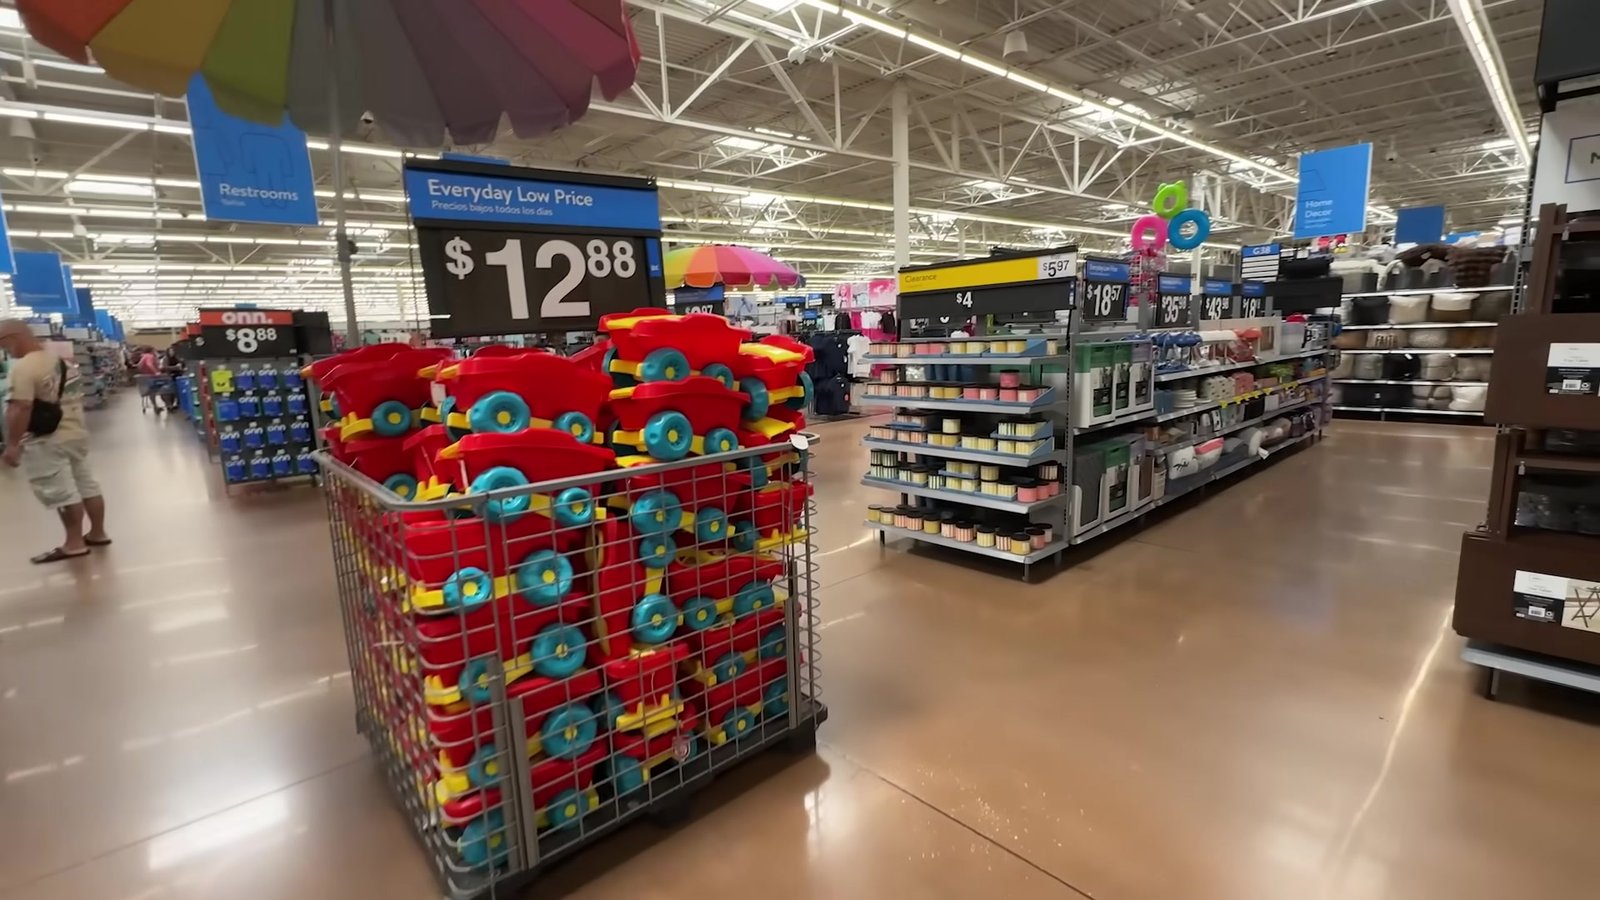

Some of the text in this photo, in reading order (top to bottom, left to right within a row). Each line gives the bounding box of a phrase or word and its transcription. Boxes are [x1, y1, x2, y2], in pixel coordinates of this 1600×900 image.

[219, 183, 299, 201] Restrooms
[427, 178, 593, 207] Everyday Low Price
[431, 199, 468, 212] Precios
[469, 202, 494, 215] bajos
[495, 204, 521, 216] todos
[522, 206, 535, 216] los
[1305, 200, 1333, 208] Home
[1304, 210, 1333, 218] Decor
[904, 273, 937, 284] Clearance
[956, 291, 973, 308] $4
[221, 311, 273, 324] onn.
